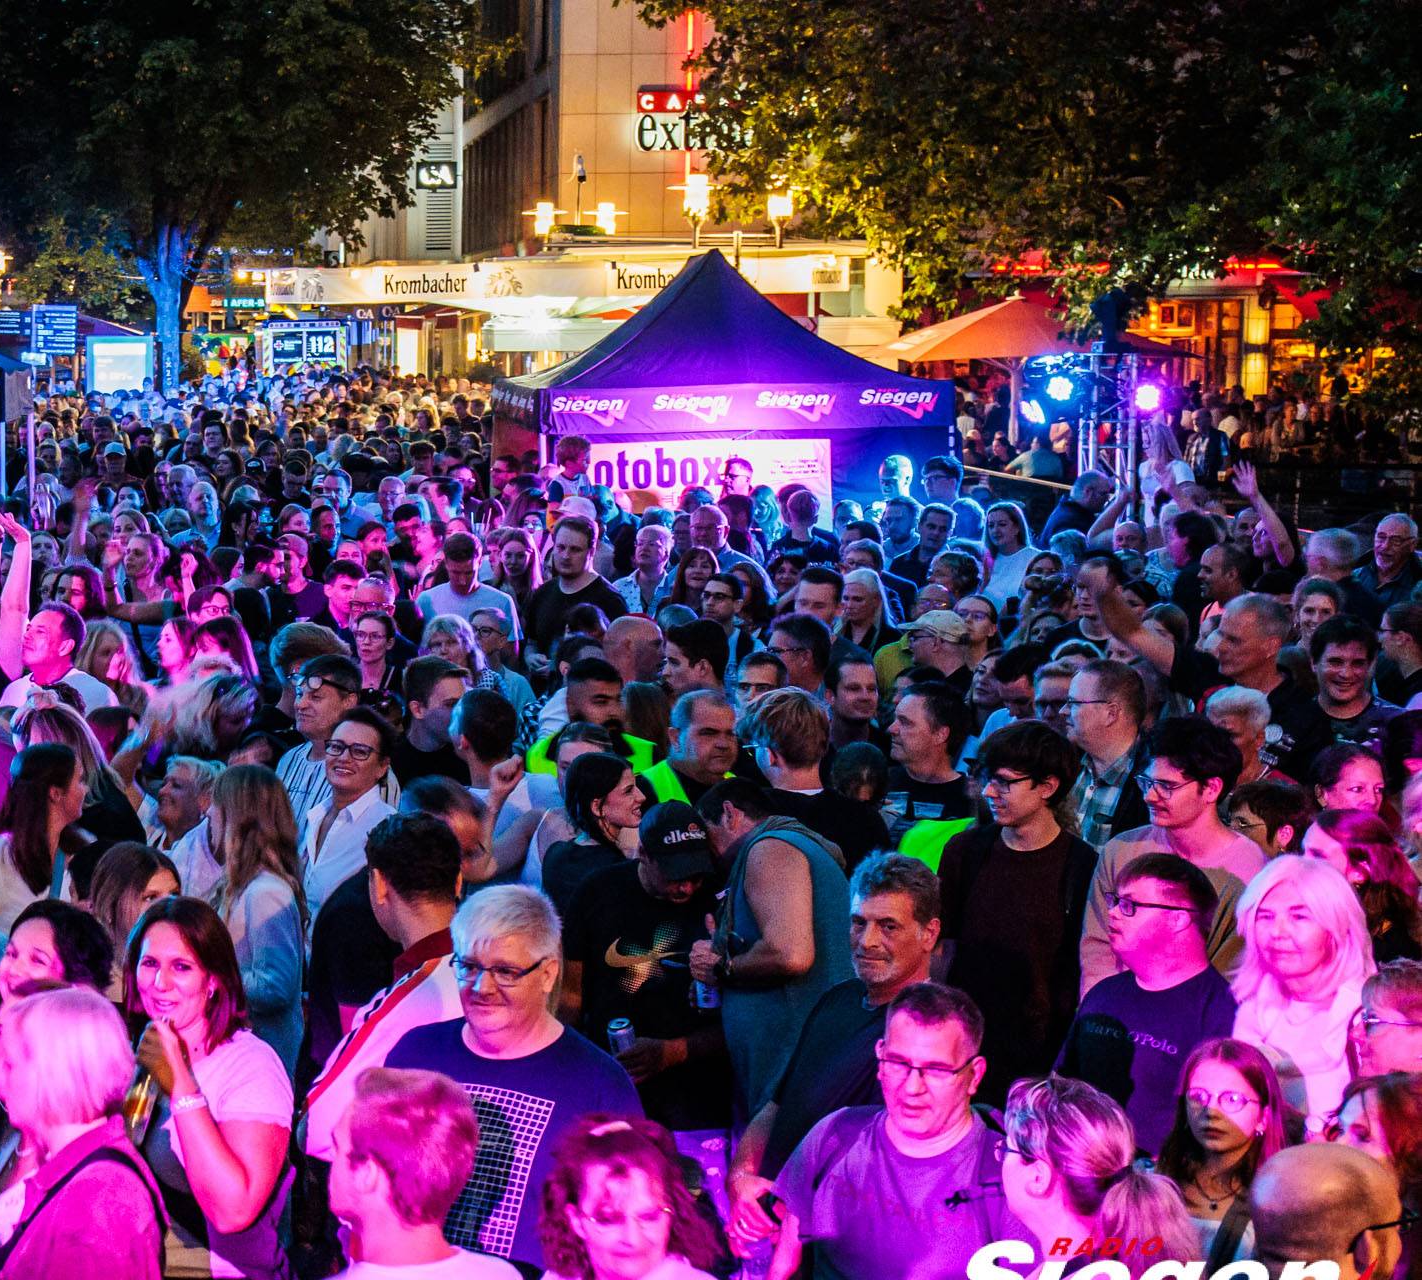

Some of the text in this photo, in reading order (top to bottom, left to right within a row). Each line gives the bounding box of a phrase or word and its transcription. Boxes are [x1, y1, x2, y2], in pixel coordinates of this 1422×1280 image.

[384, 273, 467, 295] Krombacher
[617, 268, 675, 289] Kromba
[309, 335, 335, 353] 112
[552, 396, 624, 413] Siegen
[652, 394, 727, 412] Siegen
[756, 391, 830, 409] Siegen
[859, 389, 933, 406] Siegen
[594, 447, 724, 490] otobox
